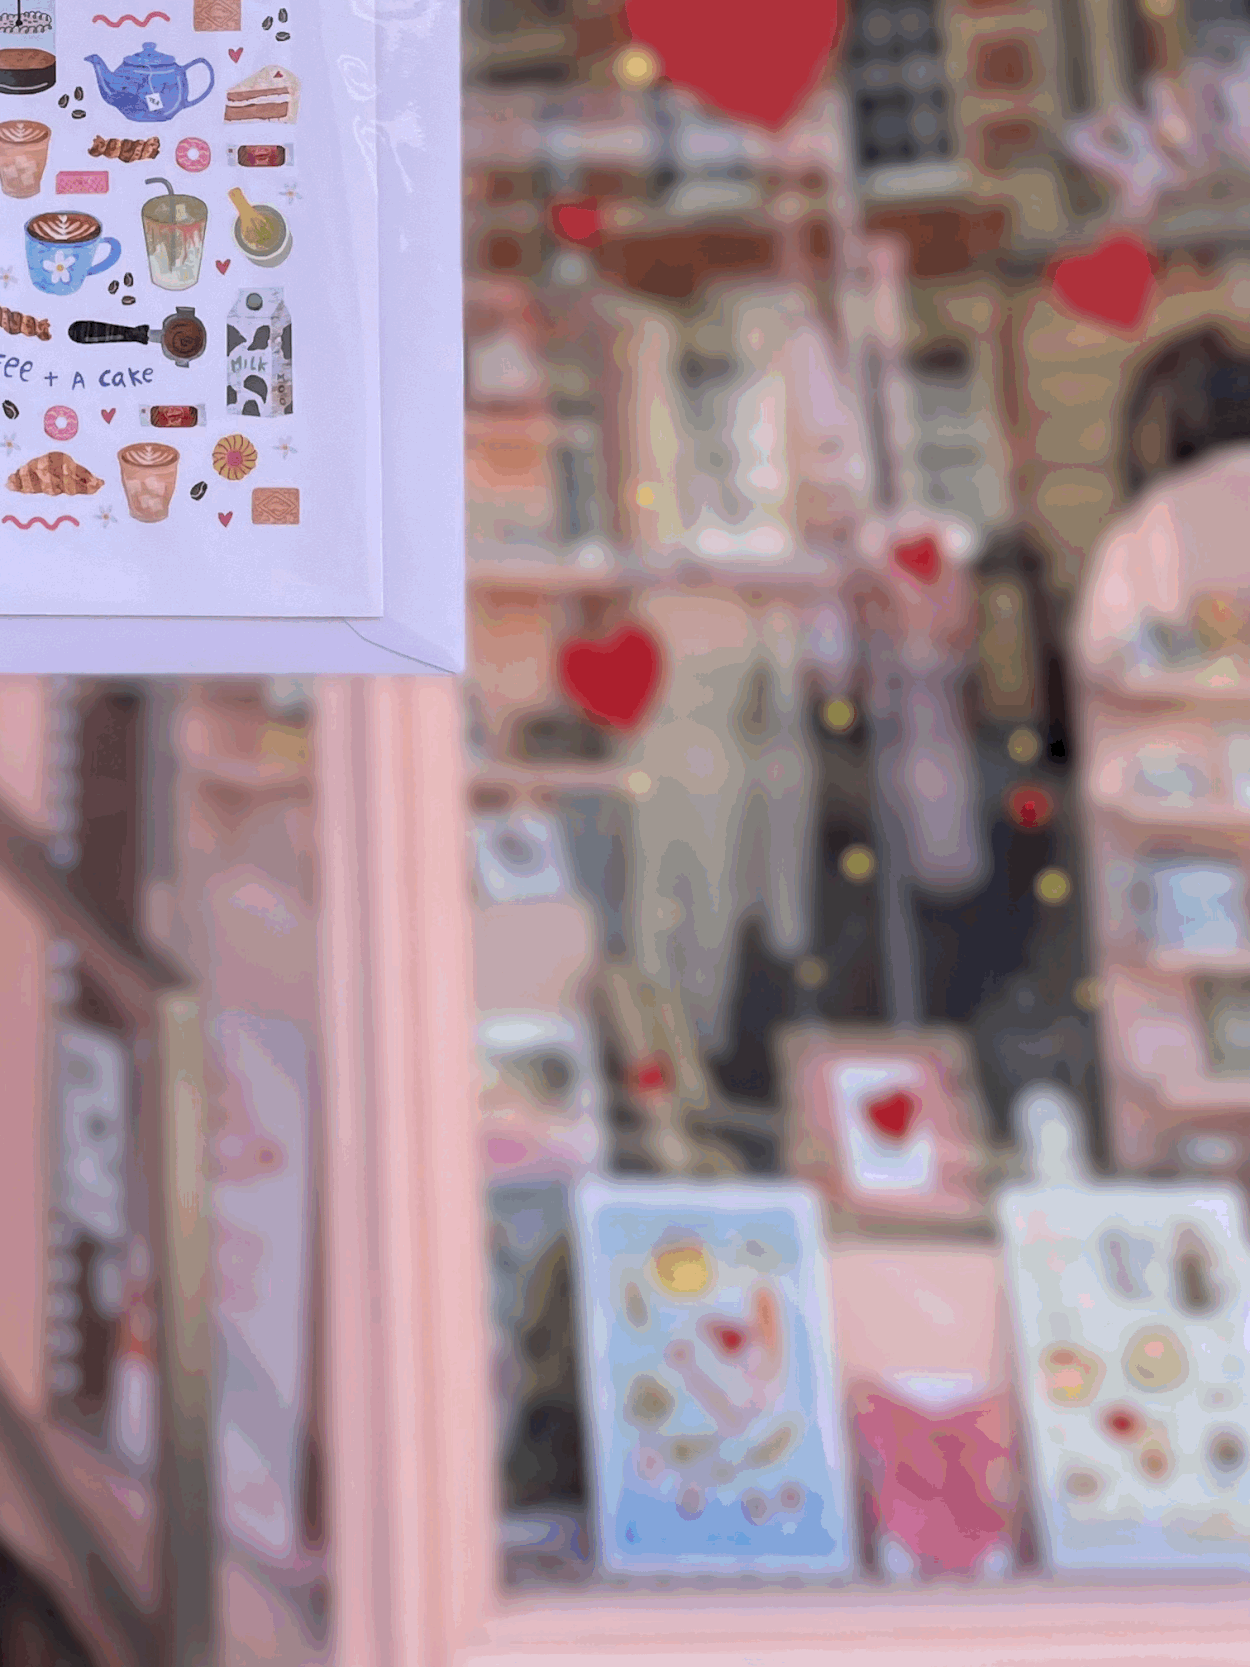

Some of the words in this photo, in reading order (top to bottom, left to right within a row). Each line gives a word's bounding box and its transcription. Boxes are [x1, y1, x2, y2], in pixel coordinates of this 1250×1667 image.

[231, 355, 268, 373] MILK
[44, 371, 59, 387] +
[71, 371, 85, 390] A
